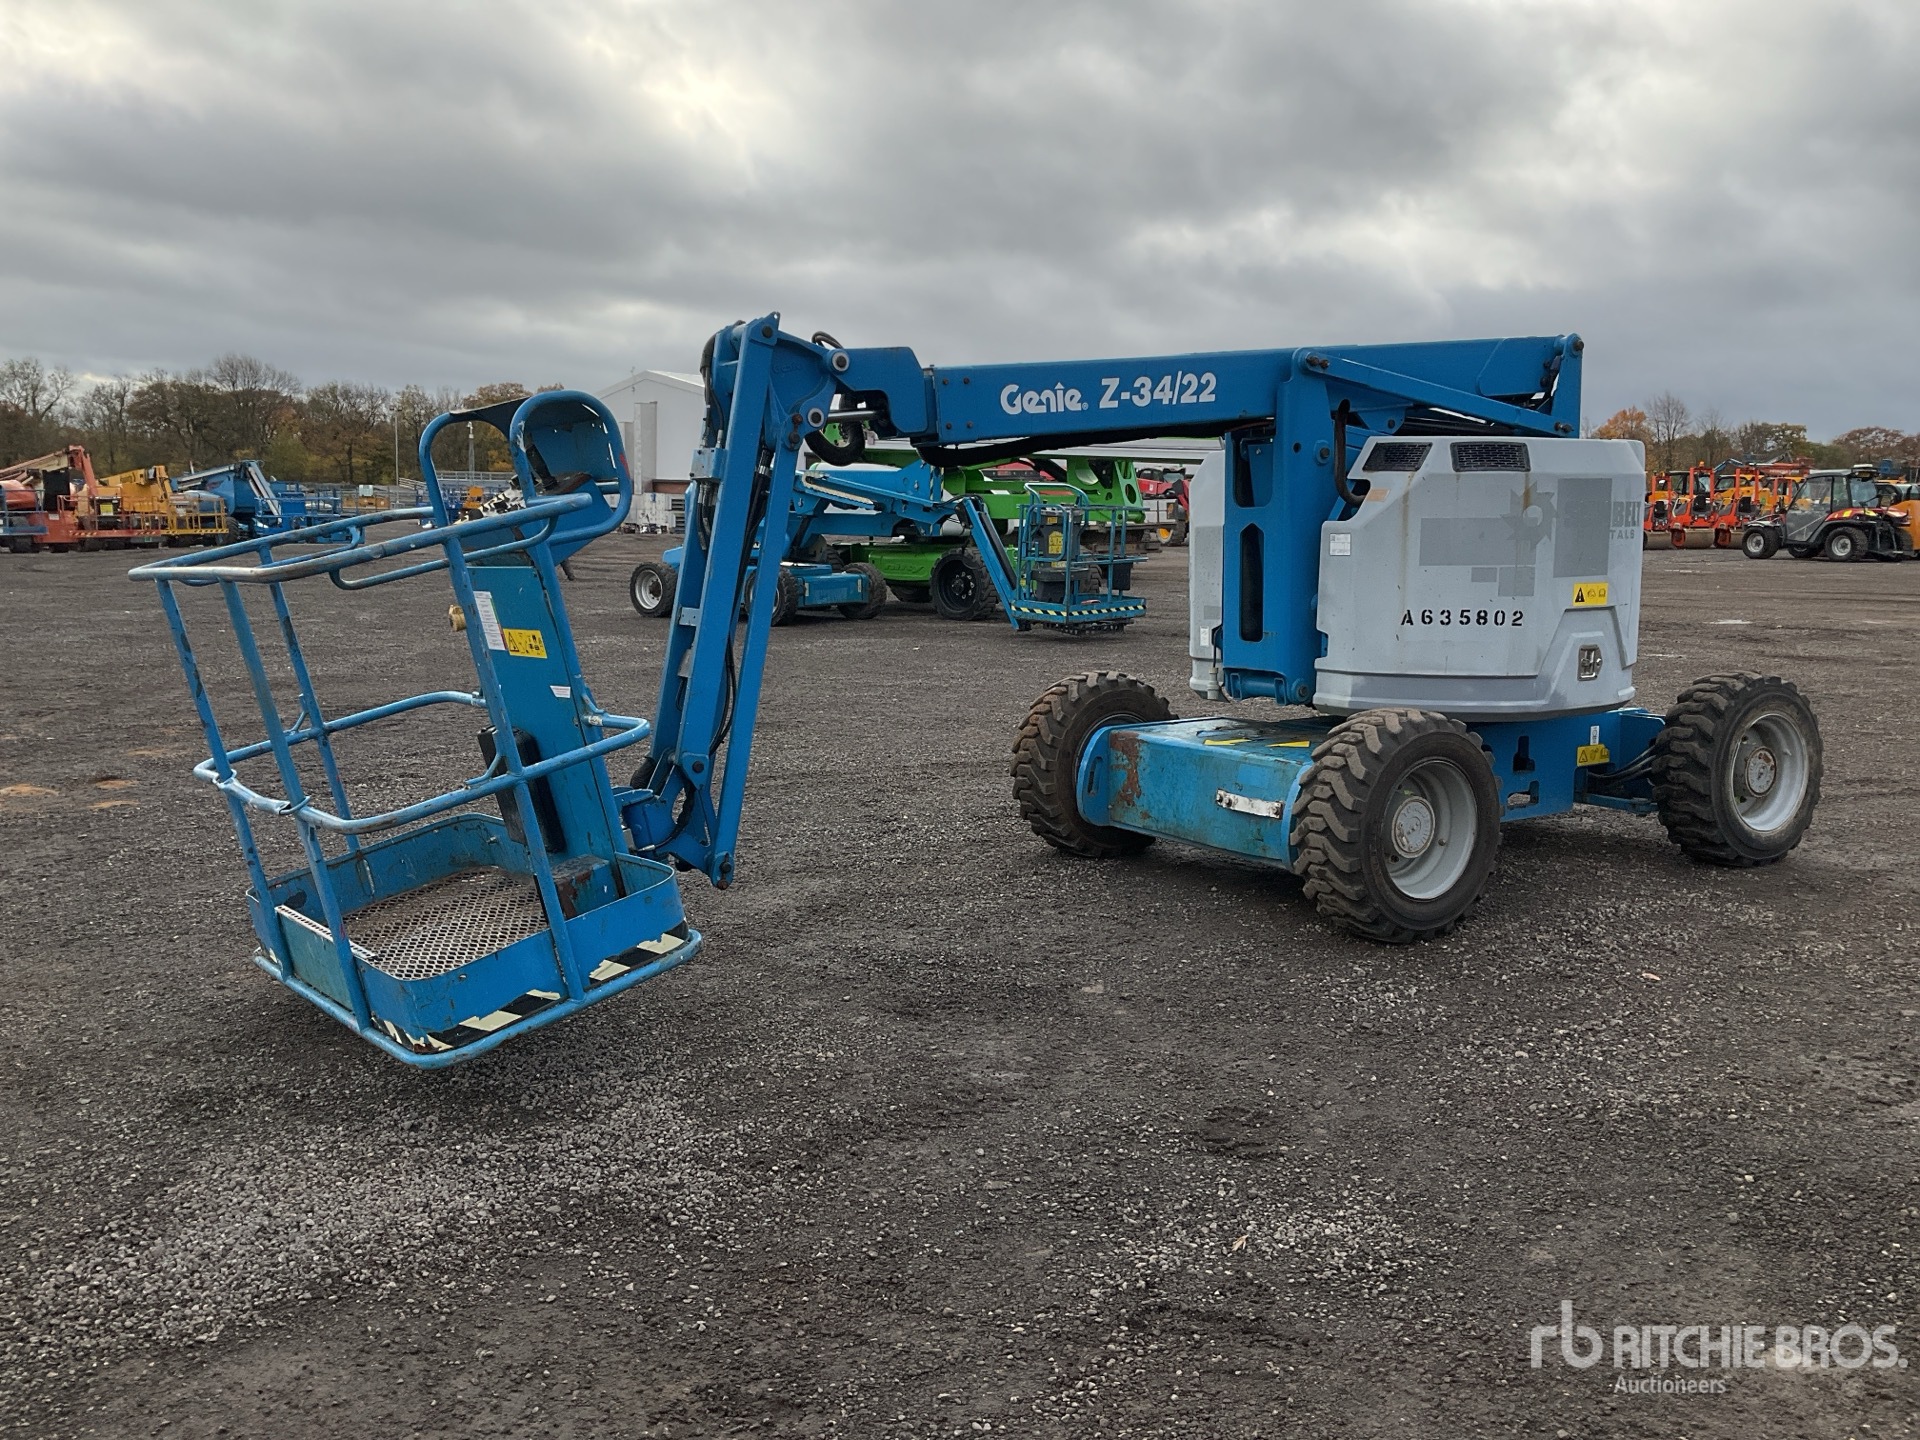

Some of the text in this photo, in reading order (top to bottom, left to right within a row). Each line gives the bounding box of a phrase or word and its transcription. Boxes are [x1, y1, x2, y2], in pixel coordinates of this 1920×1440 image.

[1000, 370, 1217, 415] Genie Z-34/22
[1401, 609, 1524, 627] A635802
